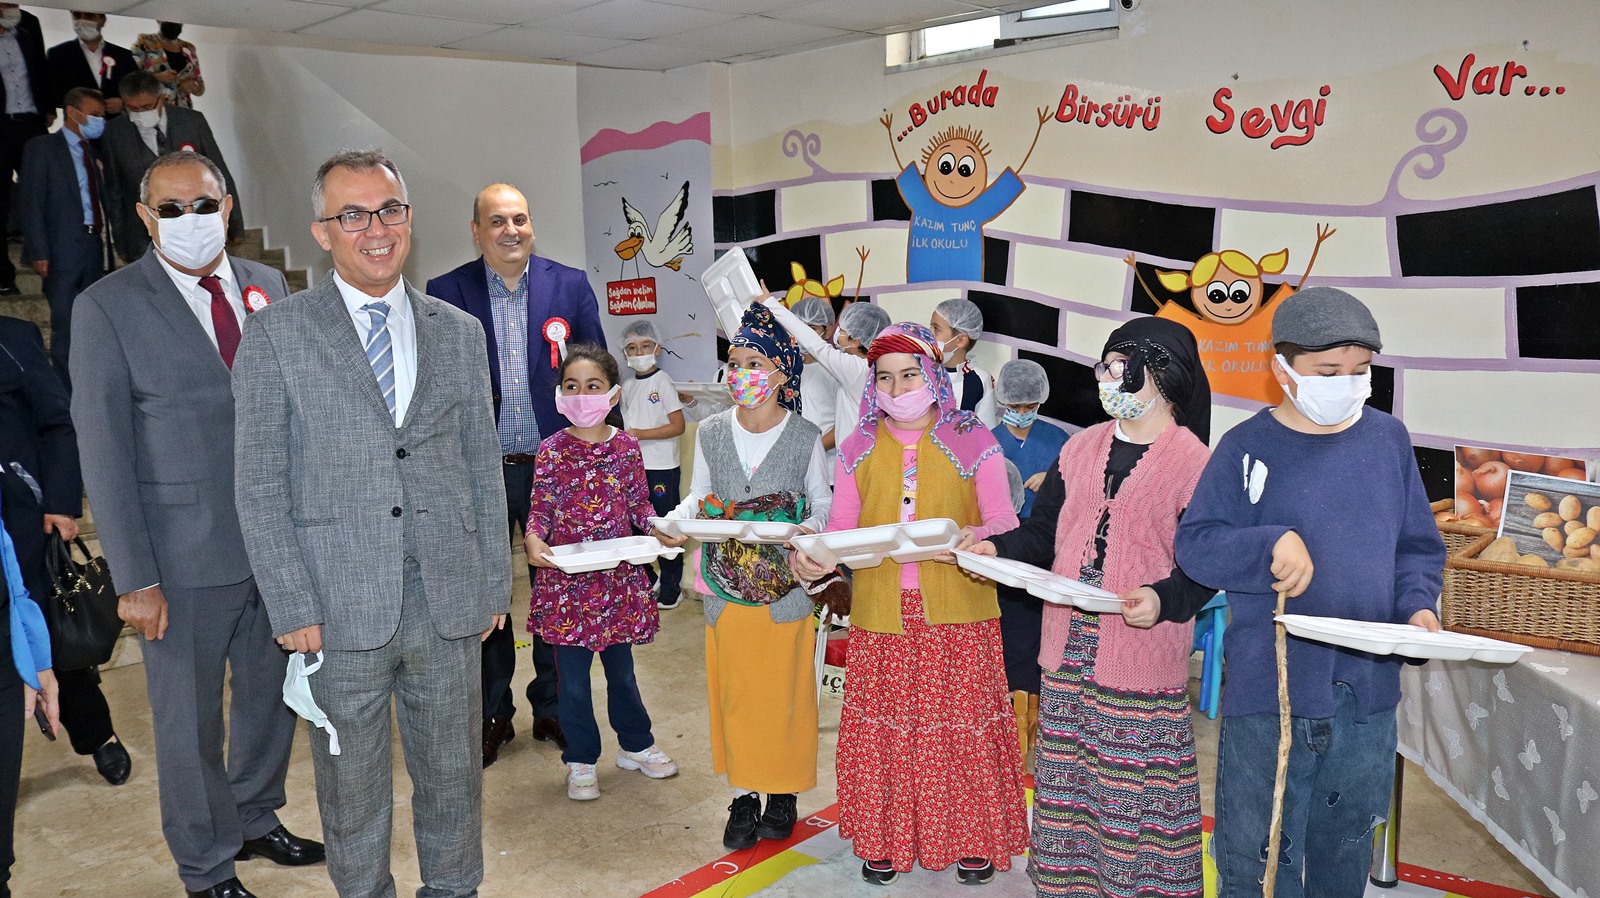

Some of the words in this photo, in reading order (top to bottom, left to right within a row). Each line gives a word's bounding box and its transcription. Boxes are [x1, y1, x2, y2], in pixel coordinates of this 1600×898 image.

[897, 69, 999, 142] ...Burada
[1055, 83, 1161, 131] Birsürü
[1206, 85, 1331, 149] Sevgi
[1434, 53, 1566, 101] Var...
[914, 216, 945, 232] KAZIM
[951, 220, 976, 232] TUNÇ
[912, 235, 929, 248] İLK
[931, 238, 968, 249] OKULU
[1198, 339, 1239, 353] KAZIM
[1221, 359, 1270, 373] OKULU
